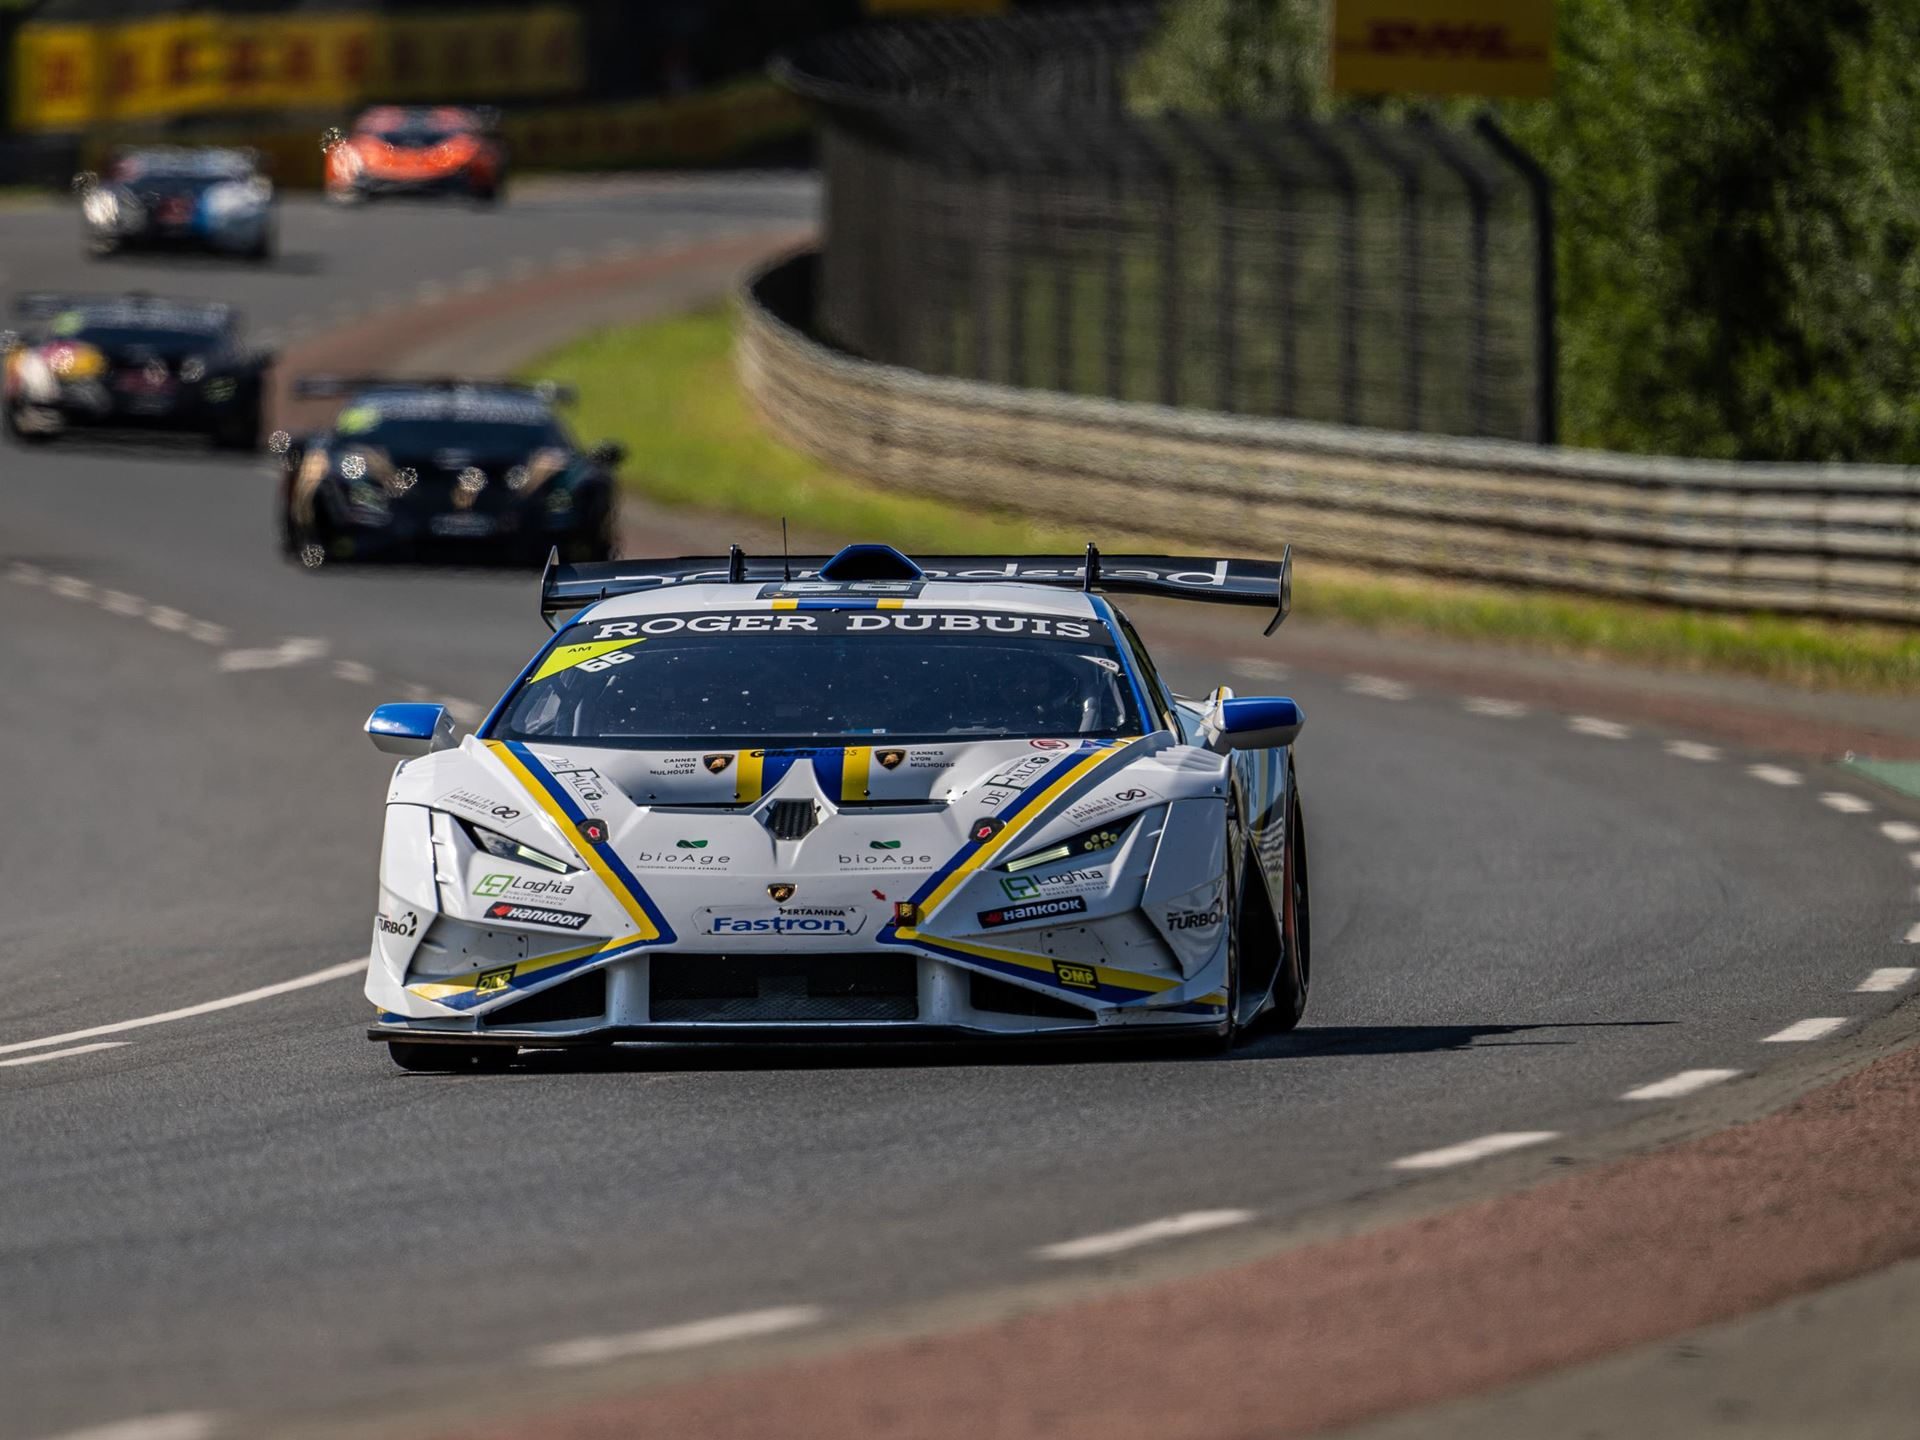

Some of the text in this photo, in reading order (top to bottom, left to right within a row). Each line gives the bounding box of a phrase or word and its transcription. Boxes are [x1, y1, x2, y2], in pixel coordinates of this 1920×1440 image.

[593, 615, 1090, 639] ROGER DUBUIS
[568, 645, 592, 654] AM
[575, 650, 636, 673] 66
[980, 790, 1009, 806] DE
[639, 852, 731, 865] bioAge
[838, 853, 932, 865] bioAge
[511, 876, 575, 895] Loghia
[1033, 870, 1103, 886] Loghia
[780, 908, 845, 917] PERTAMINA
[713, 916, 846, 932] Fastron
[1167, 911, 1218, 931] TURBO
[1059, 968, 1094, 984] OMP
